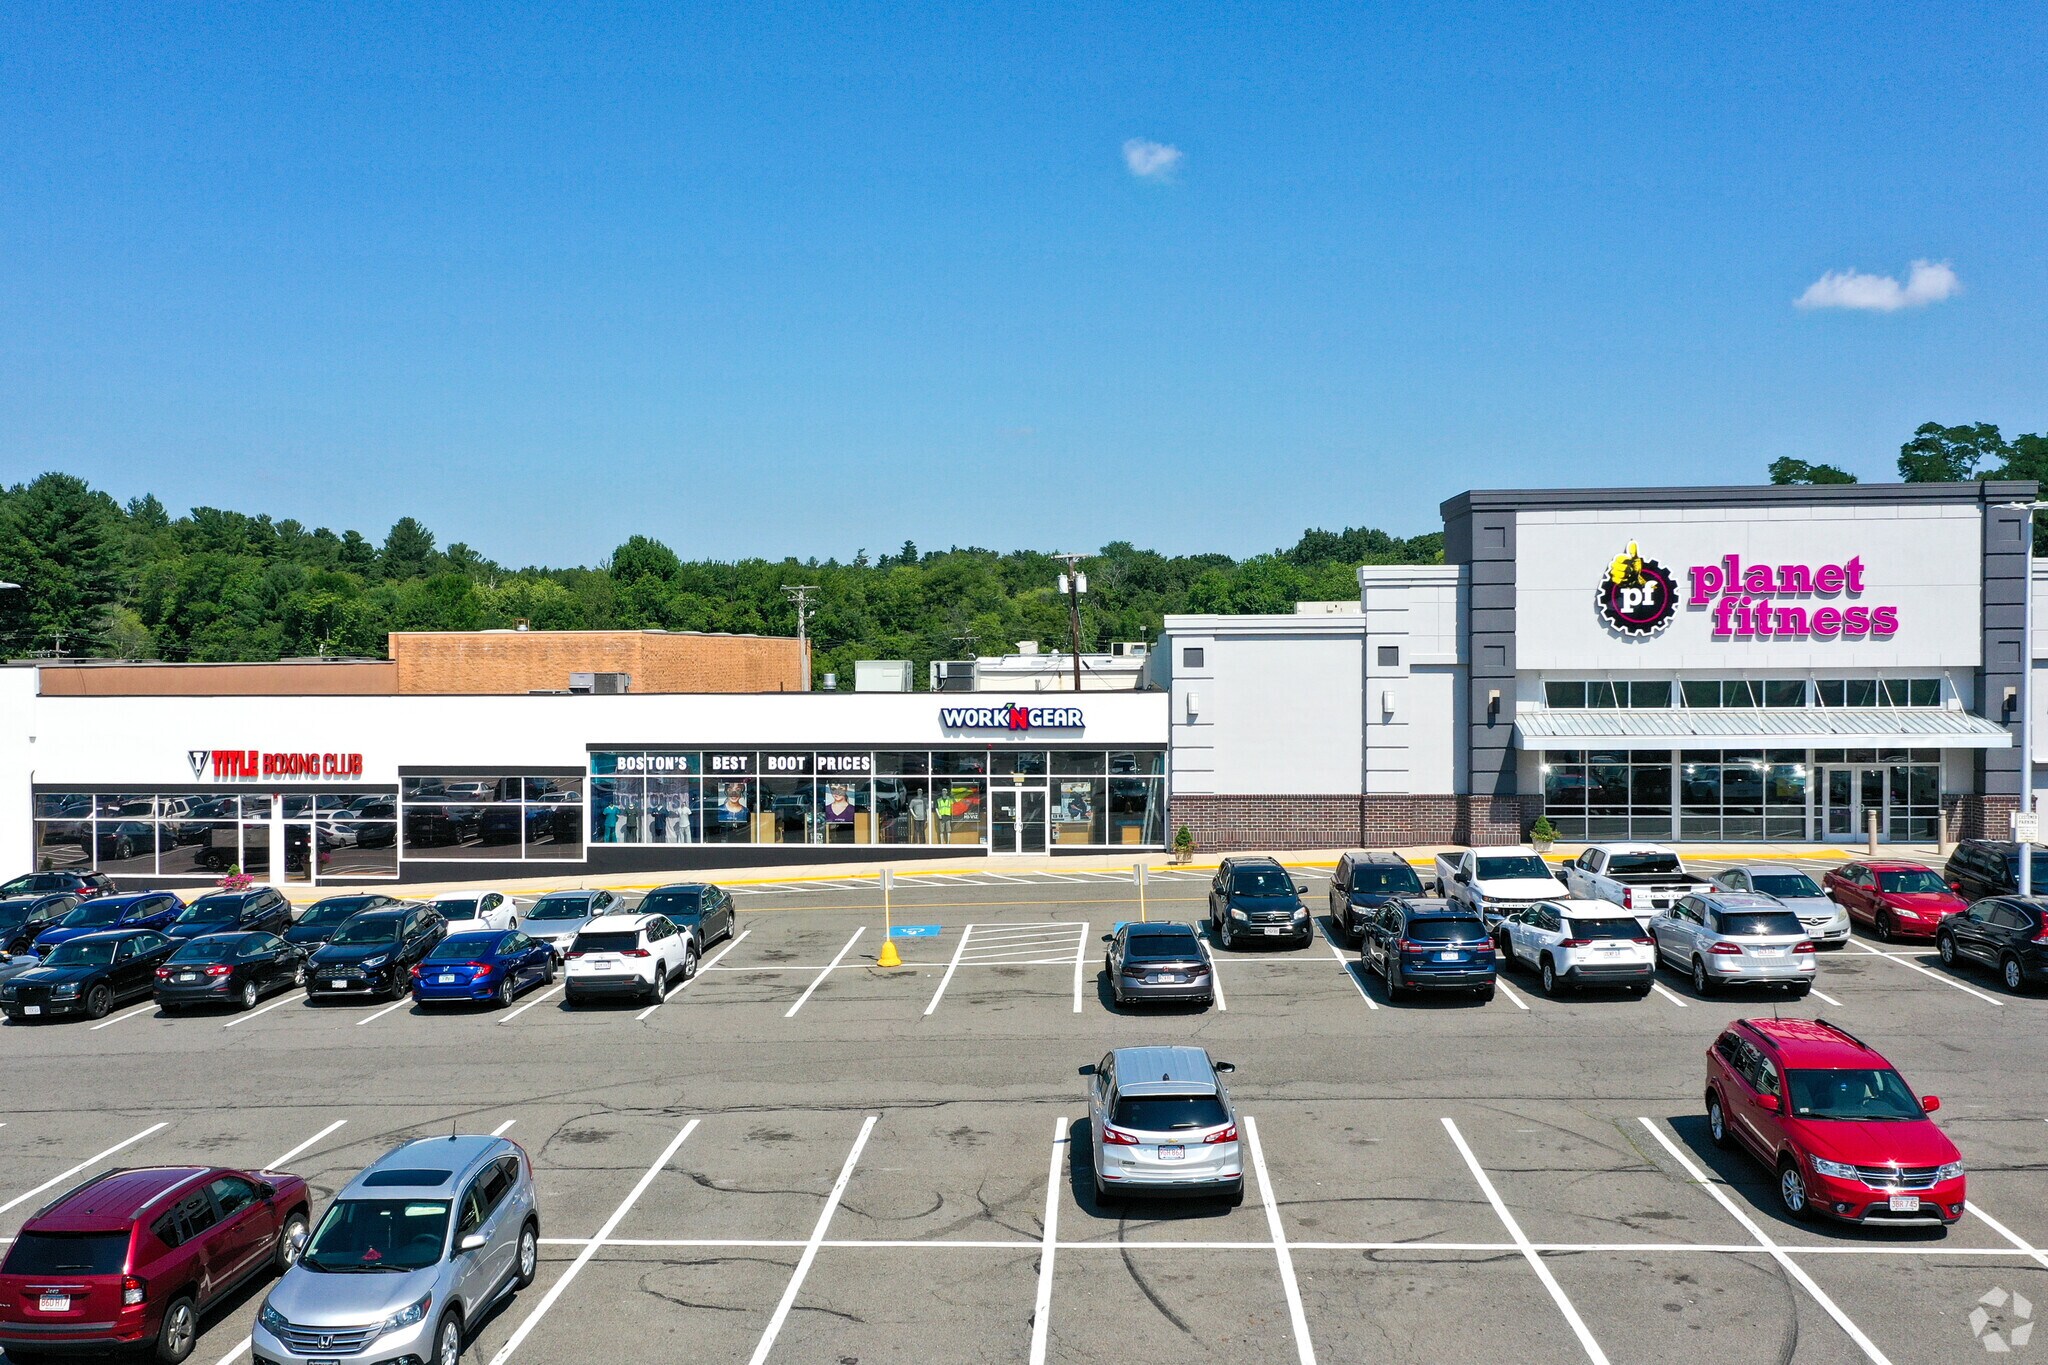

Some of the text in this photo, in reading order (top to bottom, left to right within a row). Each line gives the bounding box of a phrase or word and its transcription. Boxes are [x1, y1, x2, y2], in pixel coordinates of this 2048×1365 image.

[1689, 554, 1865, 605] planet
[1620, 580, 1657, 613] pf
[1712, 595, 1899, 636] fitness
[211, 750, 363, 777] TITLE BOXING CLUB
[617, 756, 871, 771] BOSTON'S BEST BOOT PRICES
